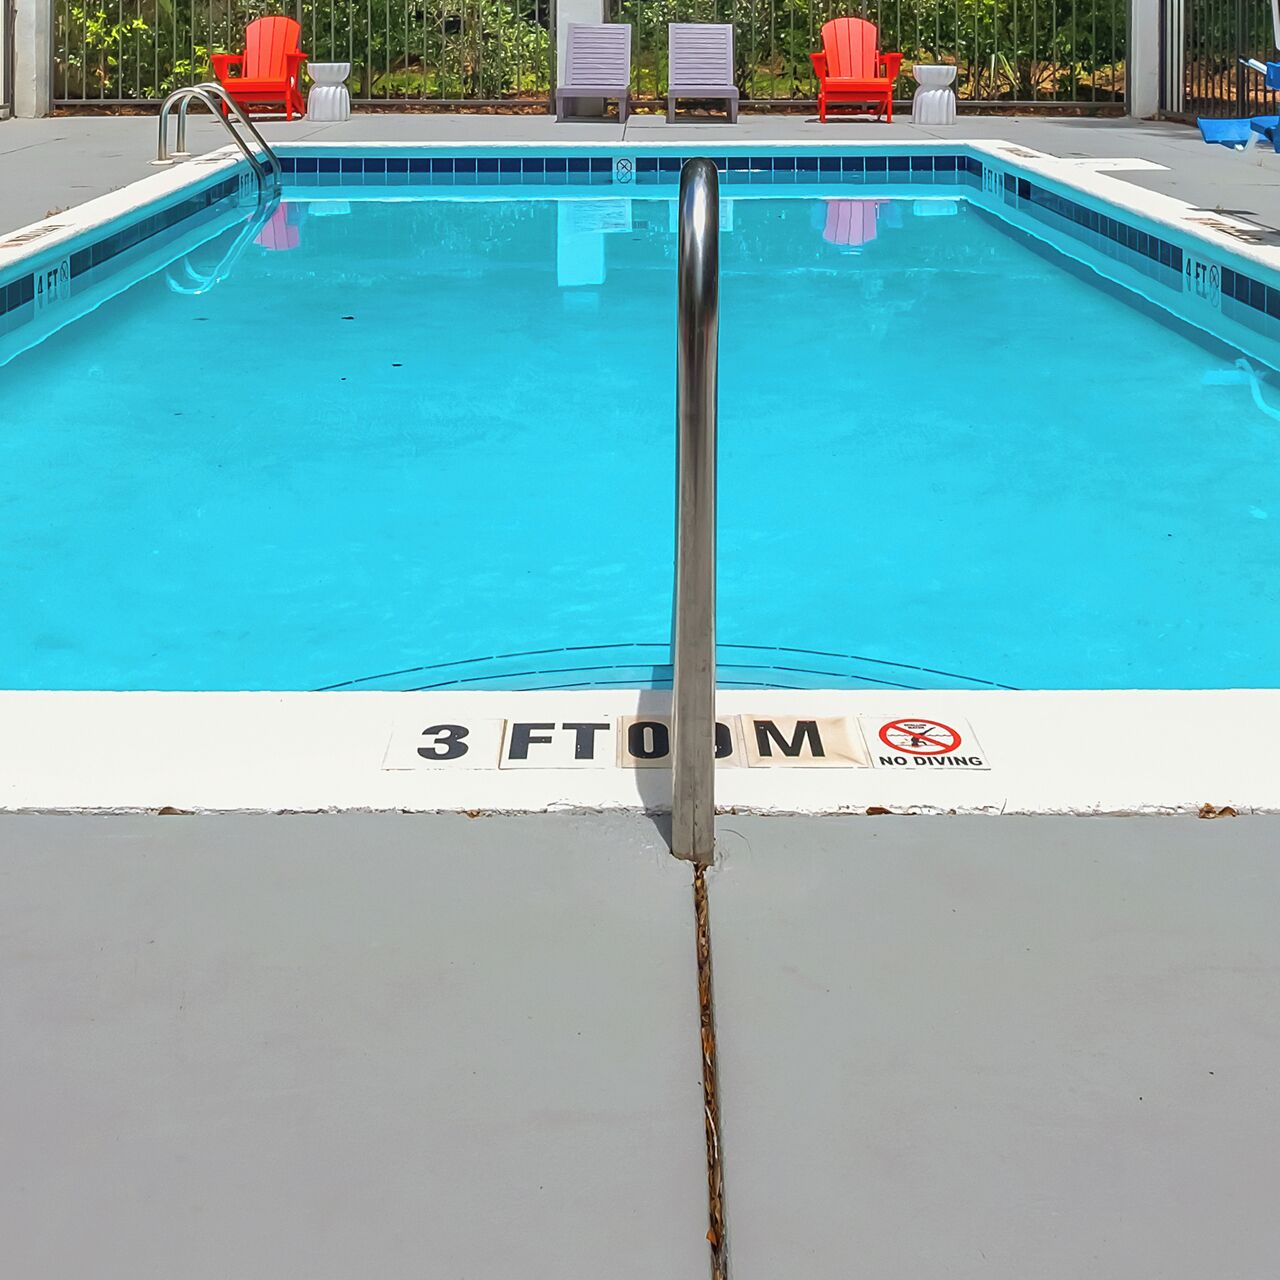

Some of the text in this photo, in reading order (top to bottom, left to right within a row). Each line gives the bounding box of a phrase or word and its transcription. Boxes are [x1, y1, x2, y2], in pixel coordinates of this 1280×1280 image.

[416, 724, 470, 761] 3
[508, 722, 611, 760] FT
[878, 756, 983, 766] NO DIVING
